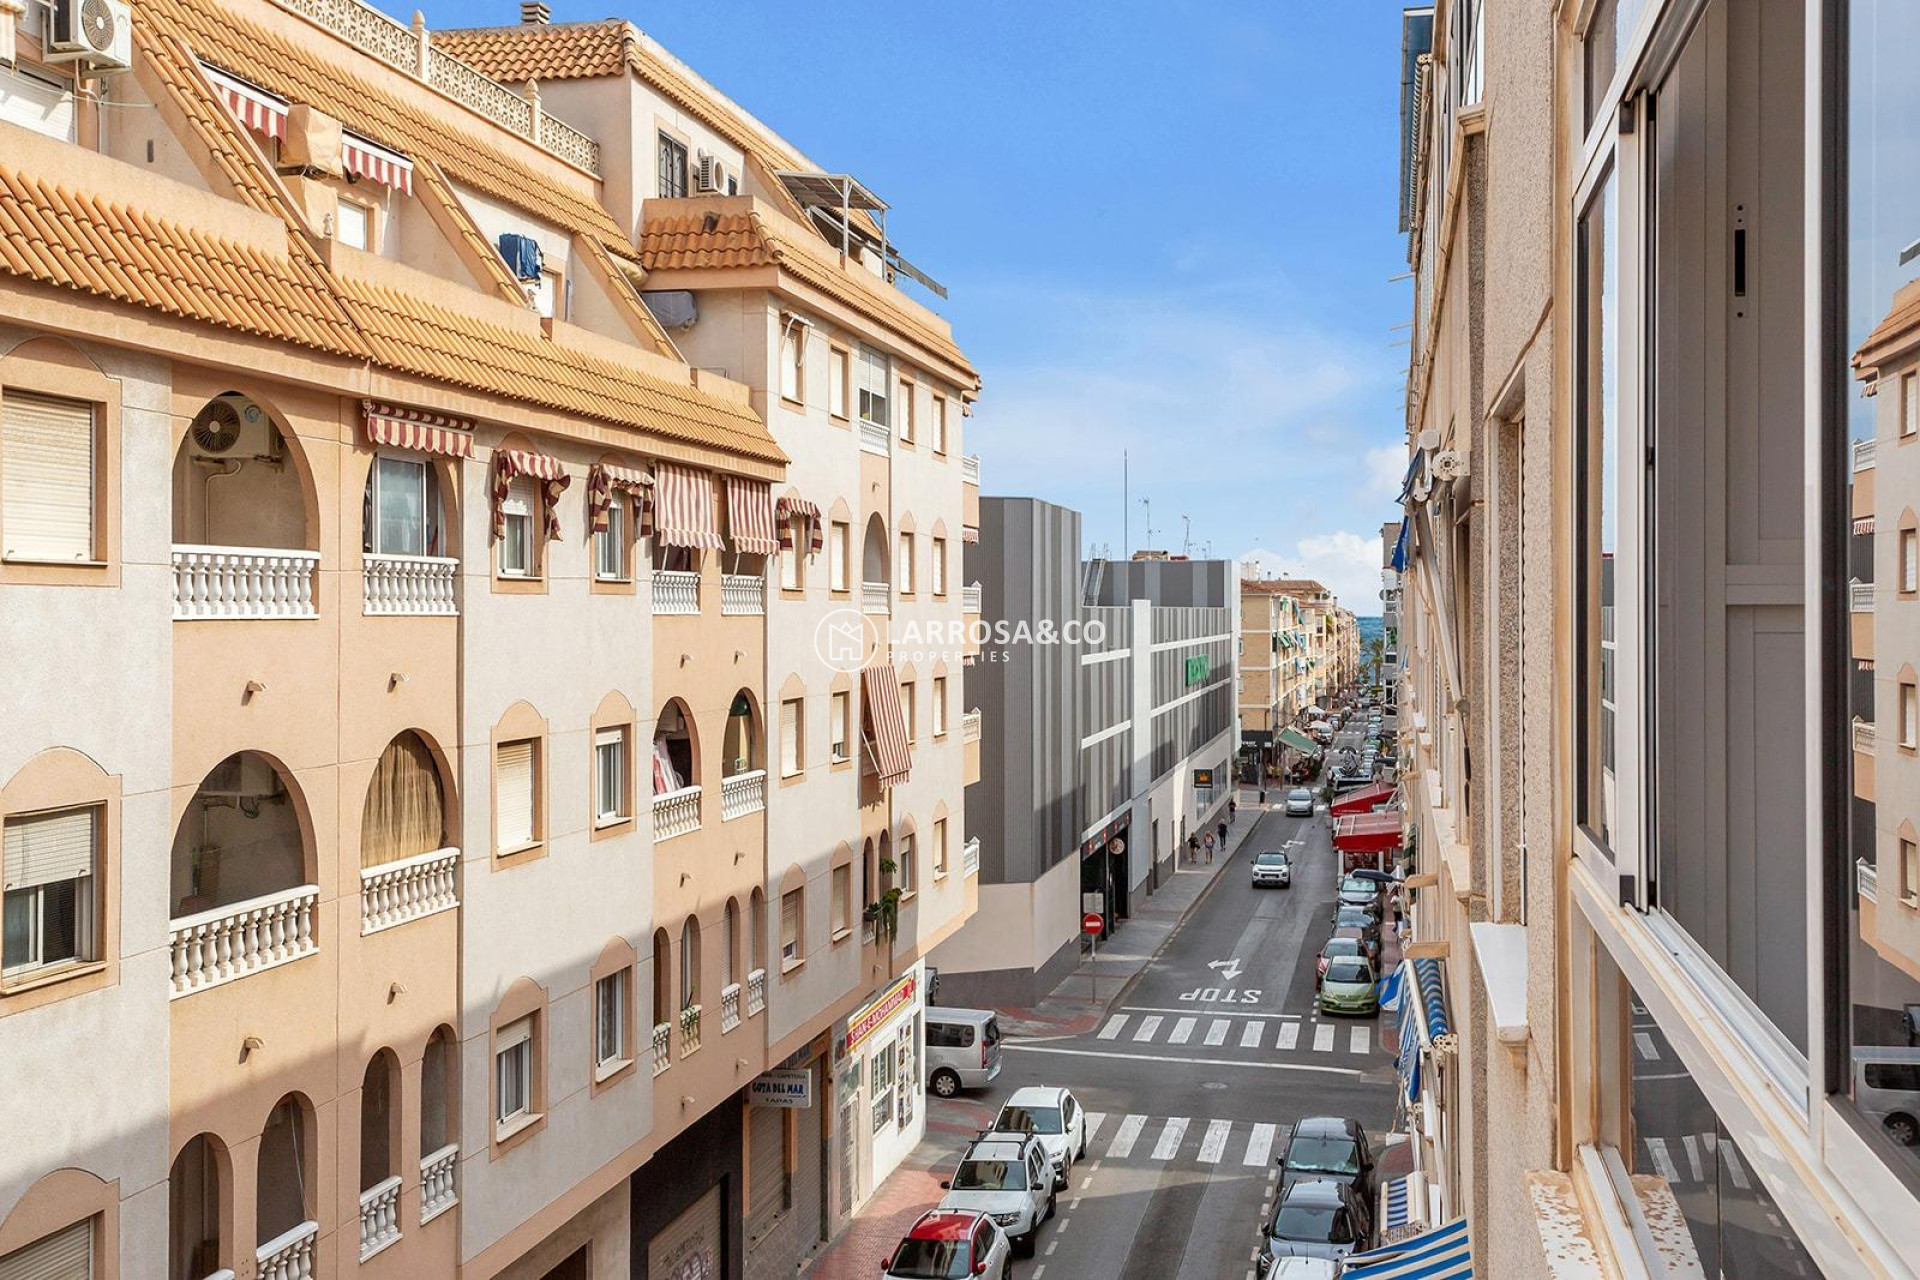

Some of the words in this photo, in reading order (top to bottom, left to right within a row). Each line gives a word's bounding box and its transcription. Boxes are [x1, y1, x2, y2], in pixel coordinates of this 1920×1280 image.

[1178, 988, 1262, 1004] STOP
[772, 1083, 785, 1093] DEL
[787, 1084, 804, 1094] MAR
